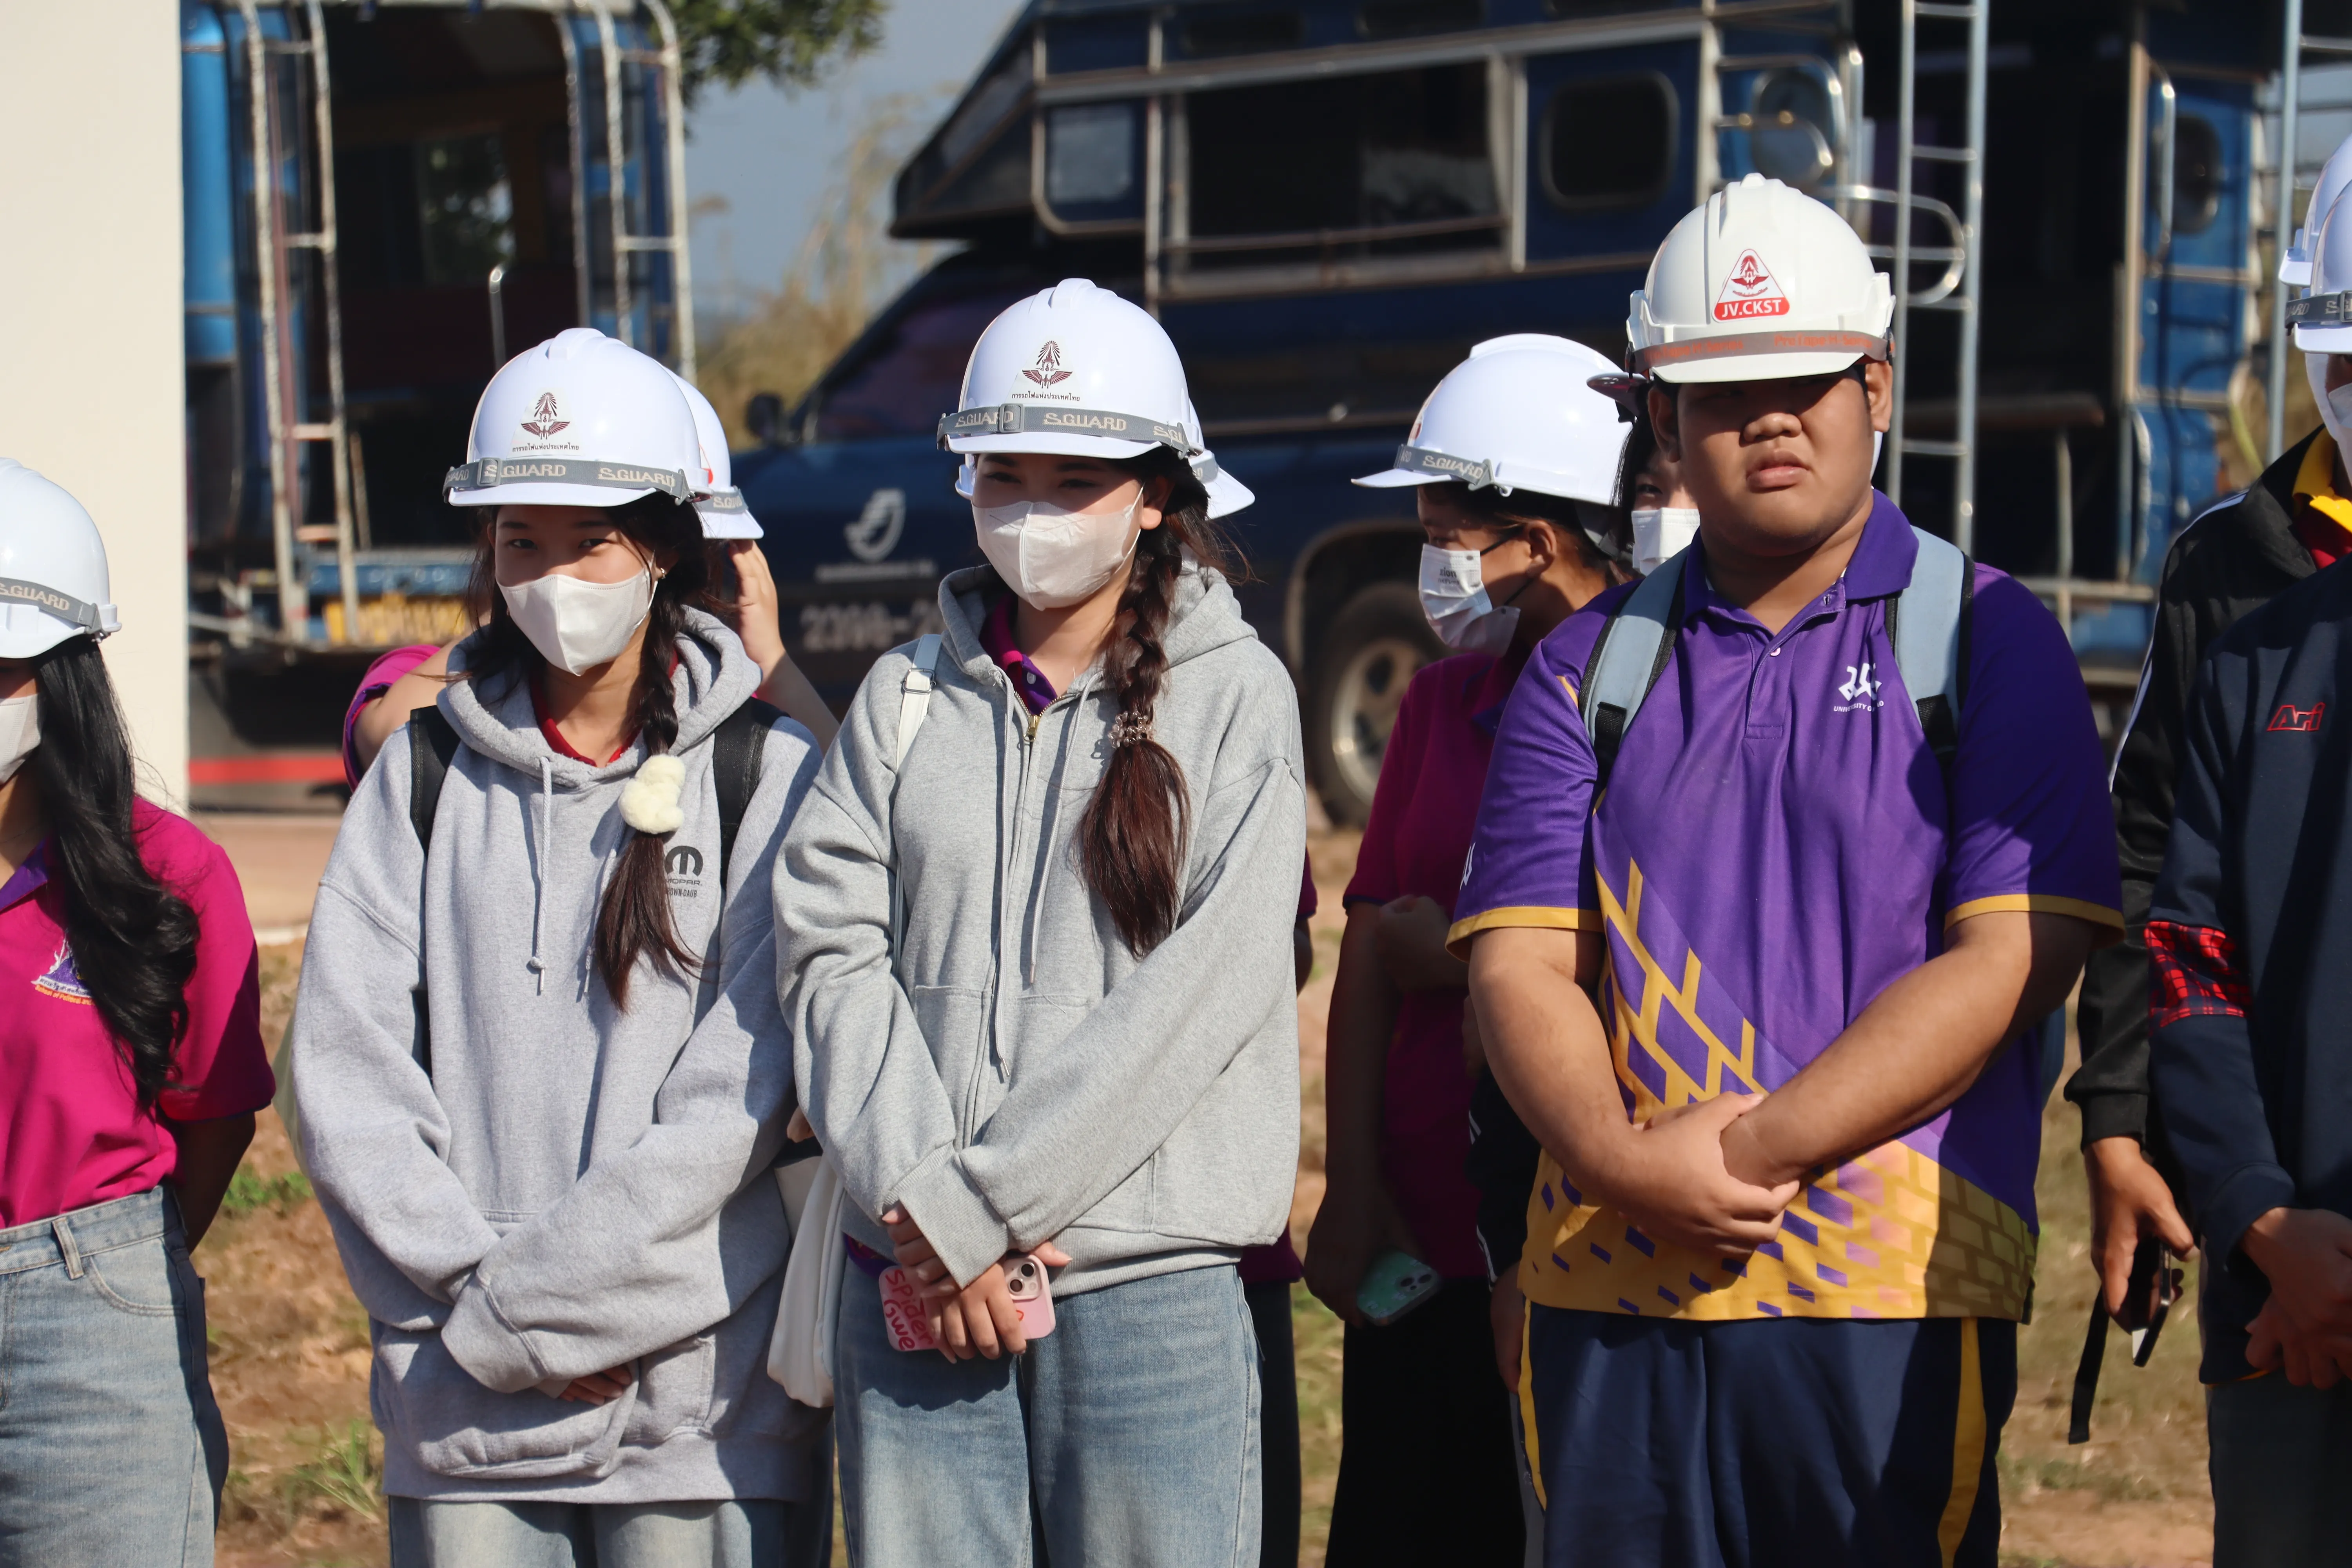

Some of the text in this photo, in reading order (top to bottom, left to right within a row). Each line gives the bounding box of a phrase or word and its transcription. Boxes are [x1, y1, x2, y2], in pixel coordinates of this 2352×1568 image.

[1722, 299, 1782, 318] JV.CKST
[1012, 390, 1080, 401] การรถไฟแห่งประเทศไทย
[1043, 412, 1127, 431] S.GUARD
[512, 442, 579, 452] การรถไฟแห่งประเทศไทย
[483, 464, 566, 478] SGUARD
[1422, 455, 1483, 479] S.GUARD
[598, 468, 676, 487] S.GUARD
[1833, 702, 1867, 712] UNIVERSITY
[2267, 702, 2325, 731] Ari
